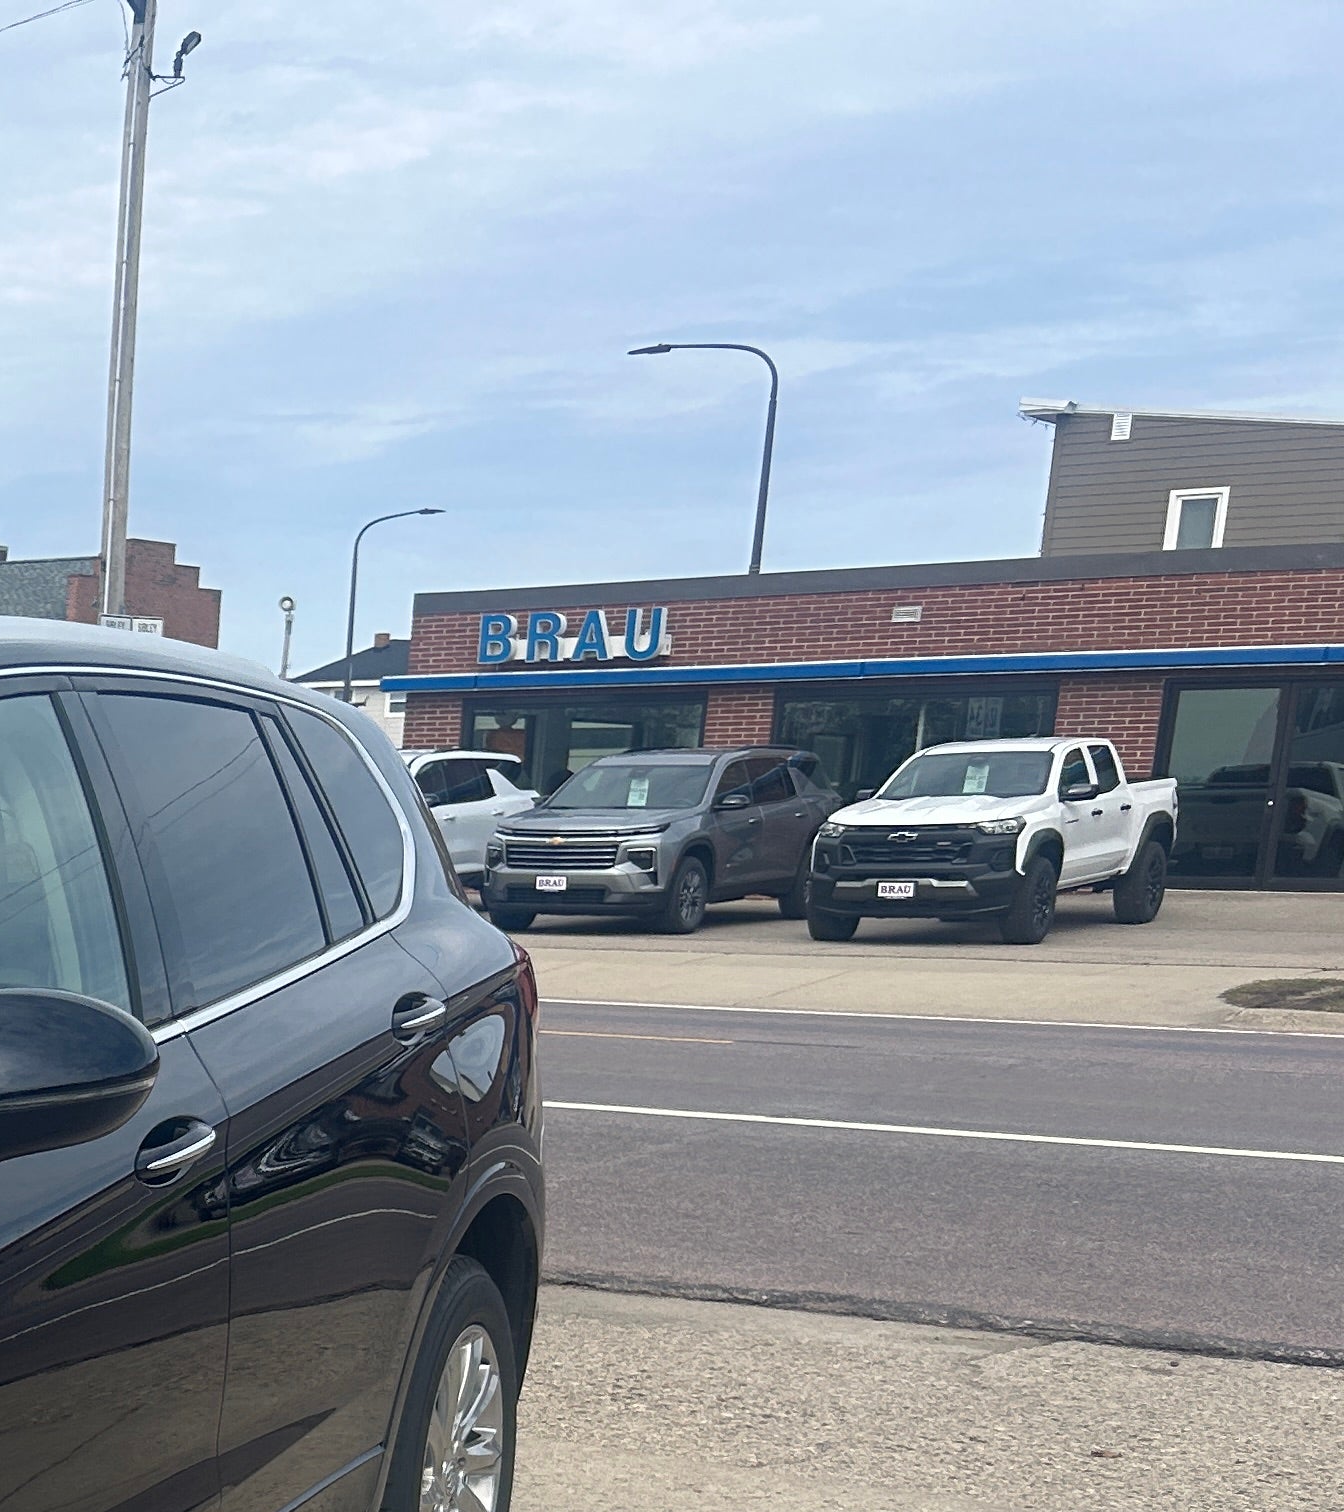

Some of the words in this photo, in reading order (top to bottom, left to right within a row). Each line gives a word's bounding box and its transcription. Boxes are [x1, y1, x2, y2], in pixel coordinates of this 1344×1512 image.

[477, 607, 667, 665] BRAU
[538, 879, 564, 887] BRAU
[880, 885, 911, 894] BRAU
